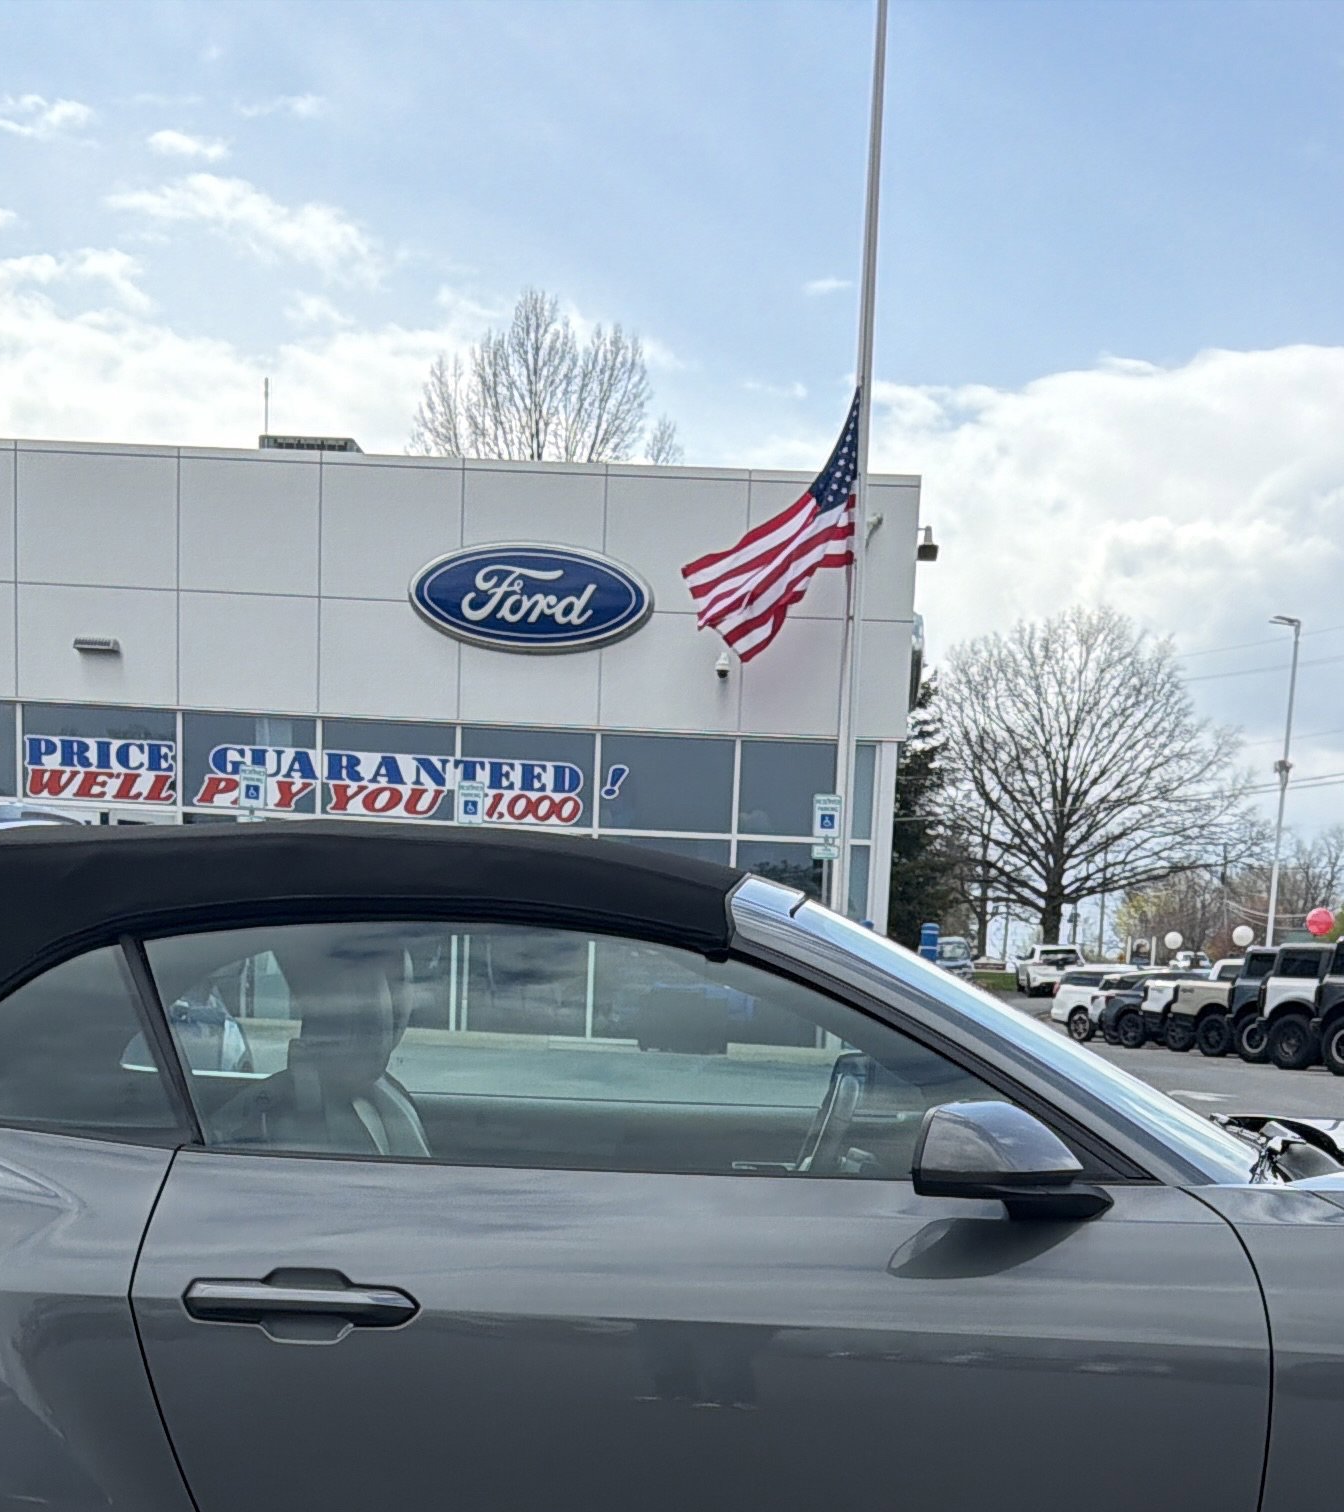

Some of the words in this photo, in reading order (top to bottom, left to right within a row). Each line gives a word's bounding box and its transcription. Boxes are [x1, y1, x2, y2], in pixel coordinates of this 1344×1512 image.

[461, 564, 598, 626] Ford
[26, 737, 175, 772] PRICE
[210, 746, 582, 794] GUARANTEED
[27, 768, 176, 802] WE'LL
[195, 776, 315, 809] PY
[328, 783, 445, 815] YOU
